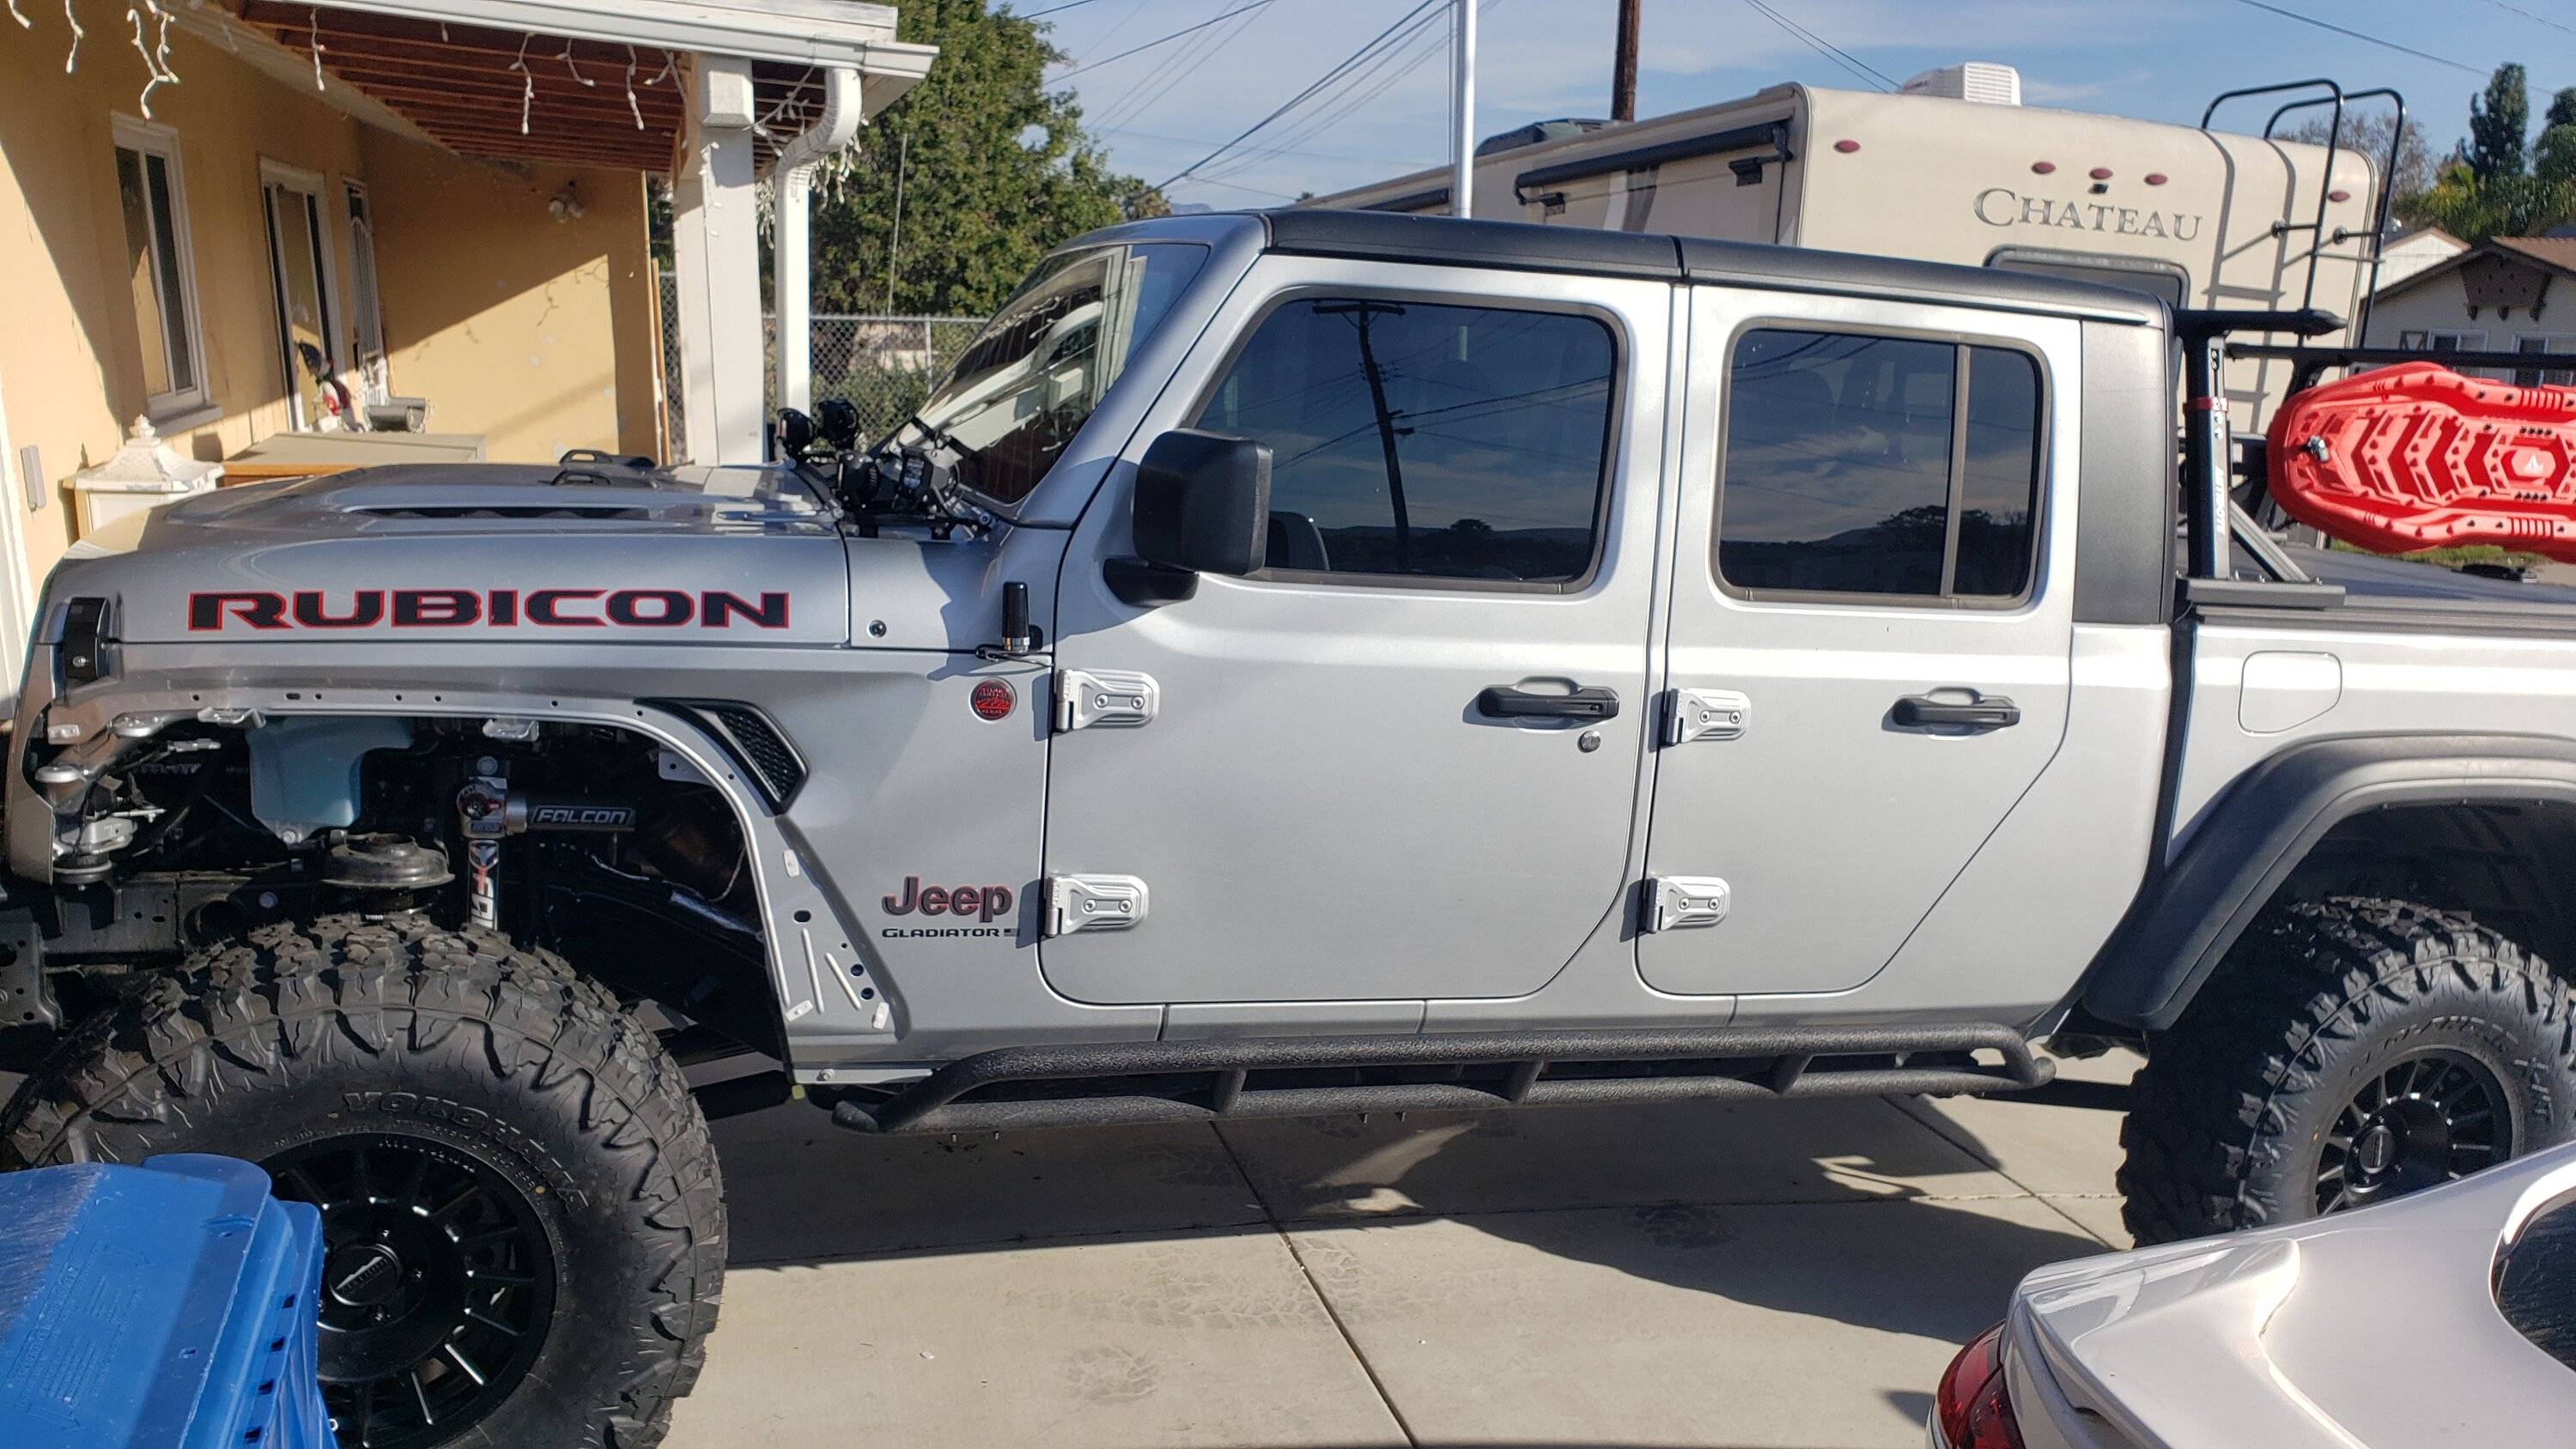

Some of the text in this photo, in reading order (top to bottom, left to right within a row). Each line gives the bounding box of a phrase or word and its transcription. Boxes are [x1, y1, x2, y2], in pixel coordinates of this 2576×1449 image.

[1972, 187, 2203, 242] CHATEAU
[186, 589, 791, 632] RUBICON
[537, 809, 626, 824] FALCON
[881, 876, 1013, 924] Jeep
[881, 928, 1000, 938] GLADIATOR
